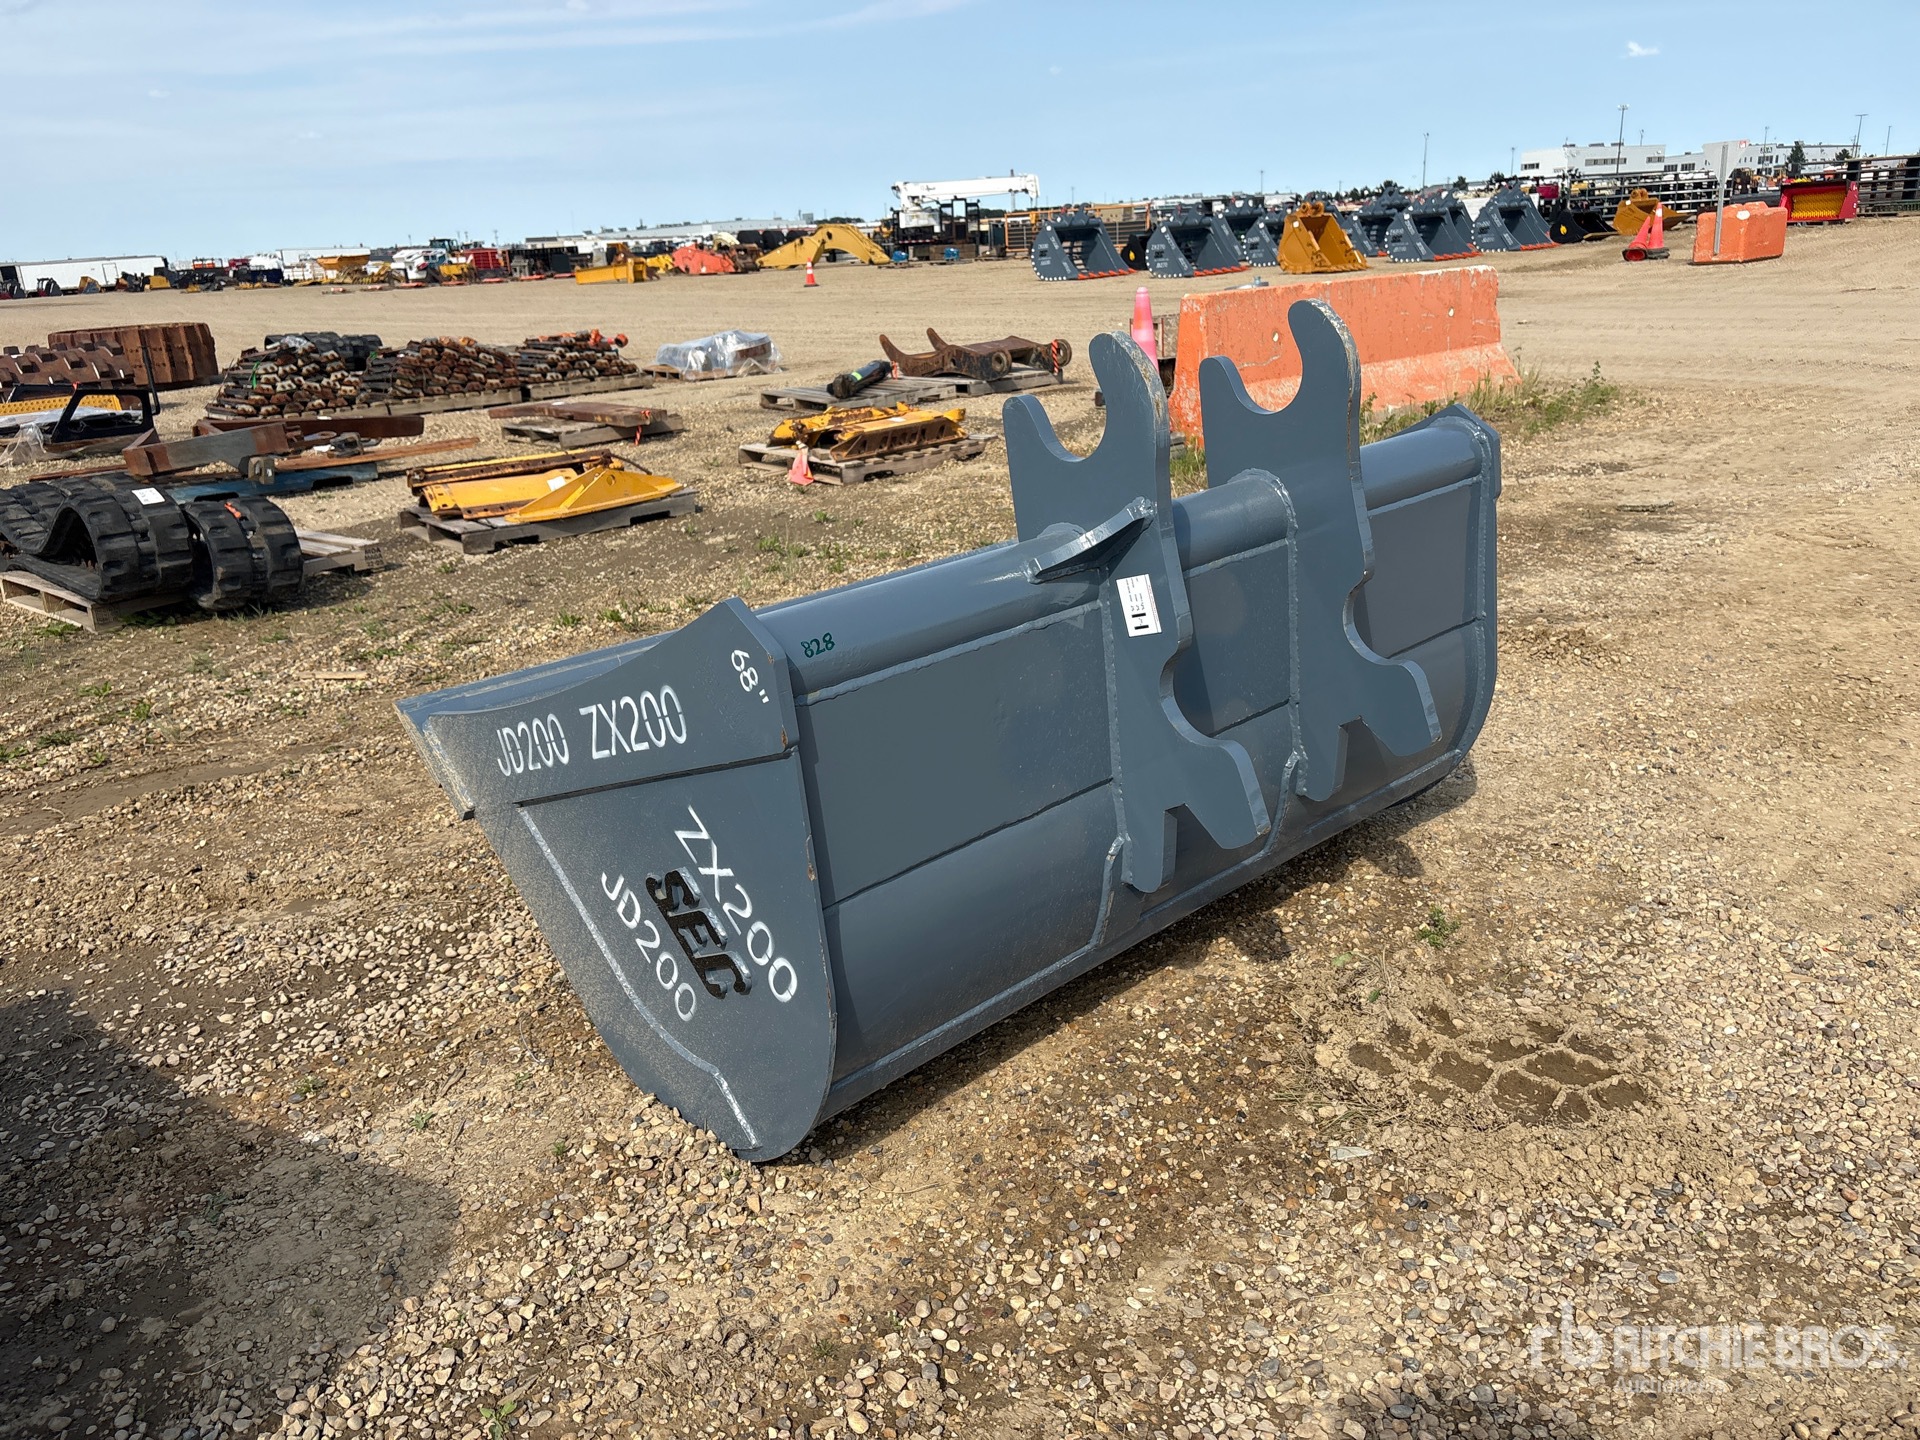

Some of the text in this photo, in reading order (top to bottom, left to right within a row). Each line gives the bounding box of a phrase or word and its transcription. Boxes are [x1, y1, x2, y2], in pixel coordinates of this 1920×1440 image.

[731, 649, 770, 704] 68"
[801, 632, 835, 658] 828
[497, 684, 687, 776] JD200 ZX200
[602, 871, 697, 1022] JD200
[645, 867, 752, 999] SEC
[674, 805, 798, 1003] ZX200
